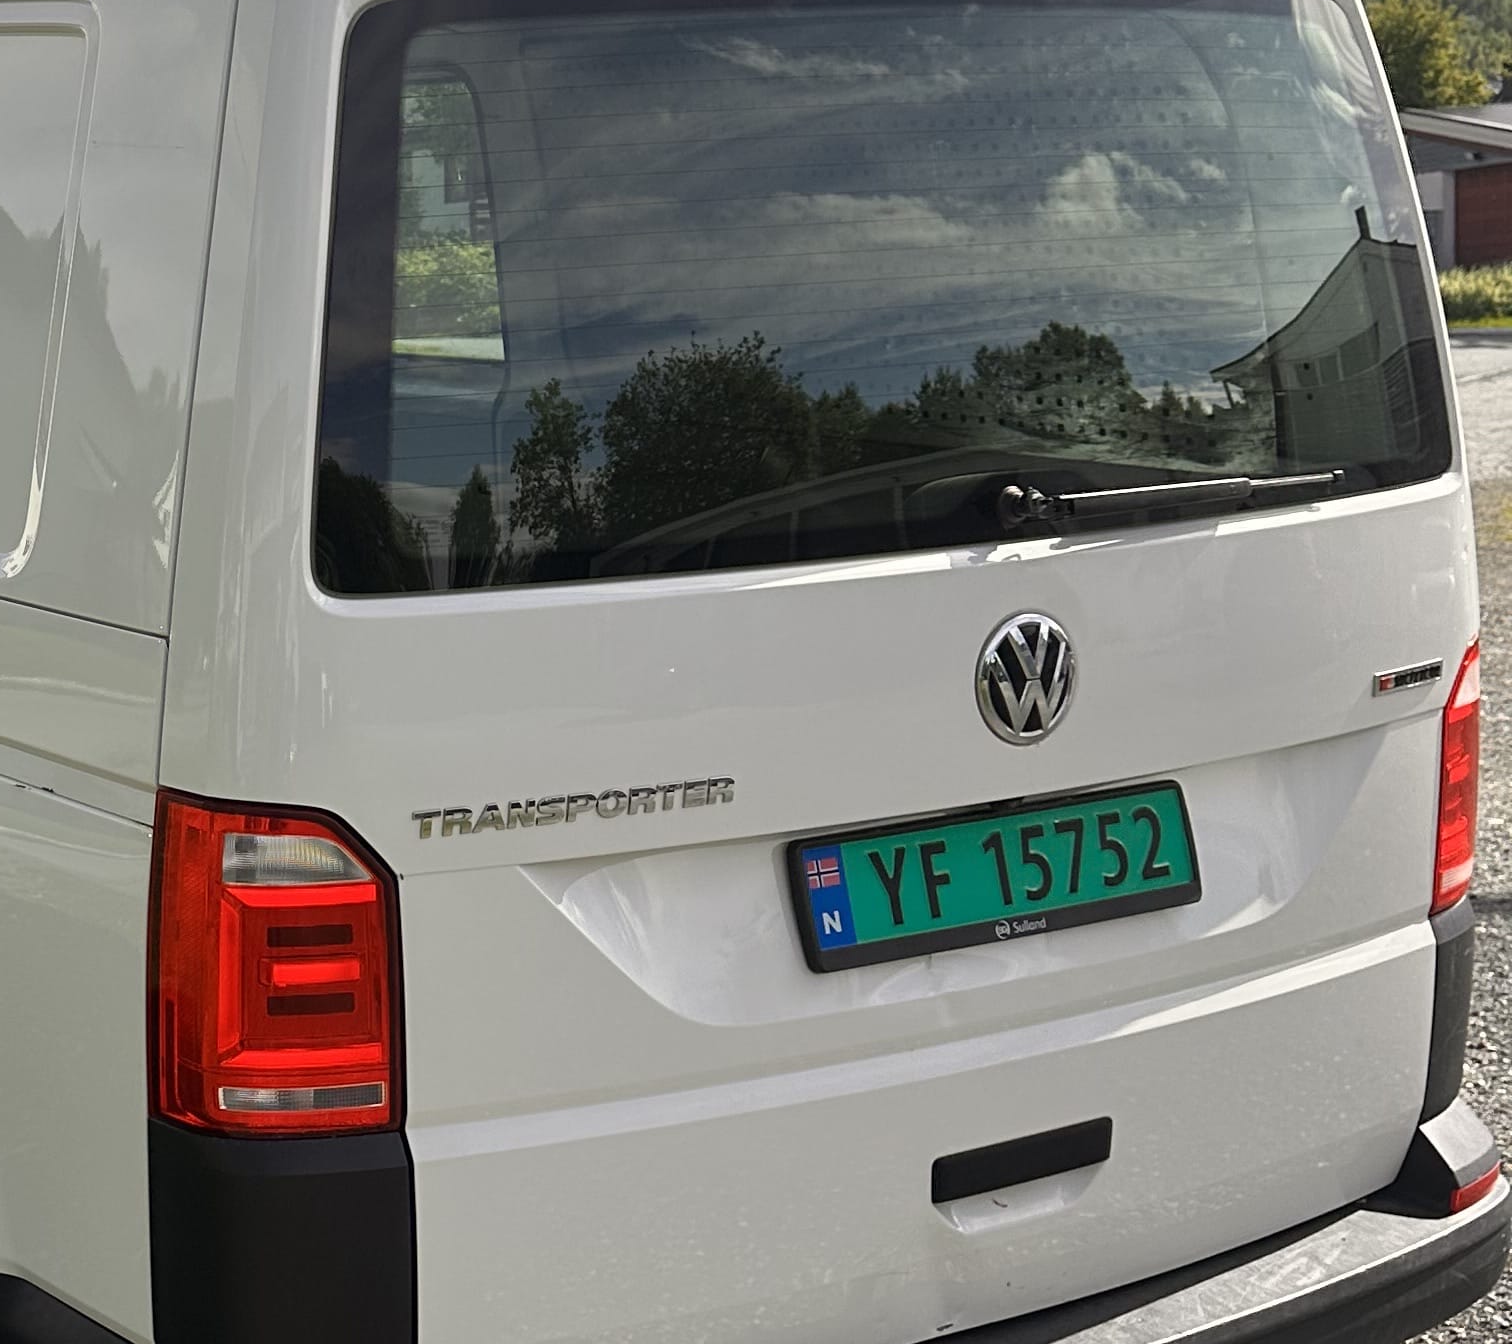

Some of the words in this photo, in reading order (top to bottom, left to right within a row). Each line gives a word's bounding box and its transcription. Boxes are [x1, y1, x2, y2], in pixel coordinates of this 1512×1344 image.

[979, 612, 1075, 742] VW
[412, 775, 736, 840] TRANSPORTER
[867, 840, 951, 926] YF
[981, 806, 1171, 906] 15752
[822, 910, 843, 935] N
[1012, 916, 1047, 934] Sulland
